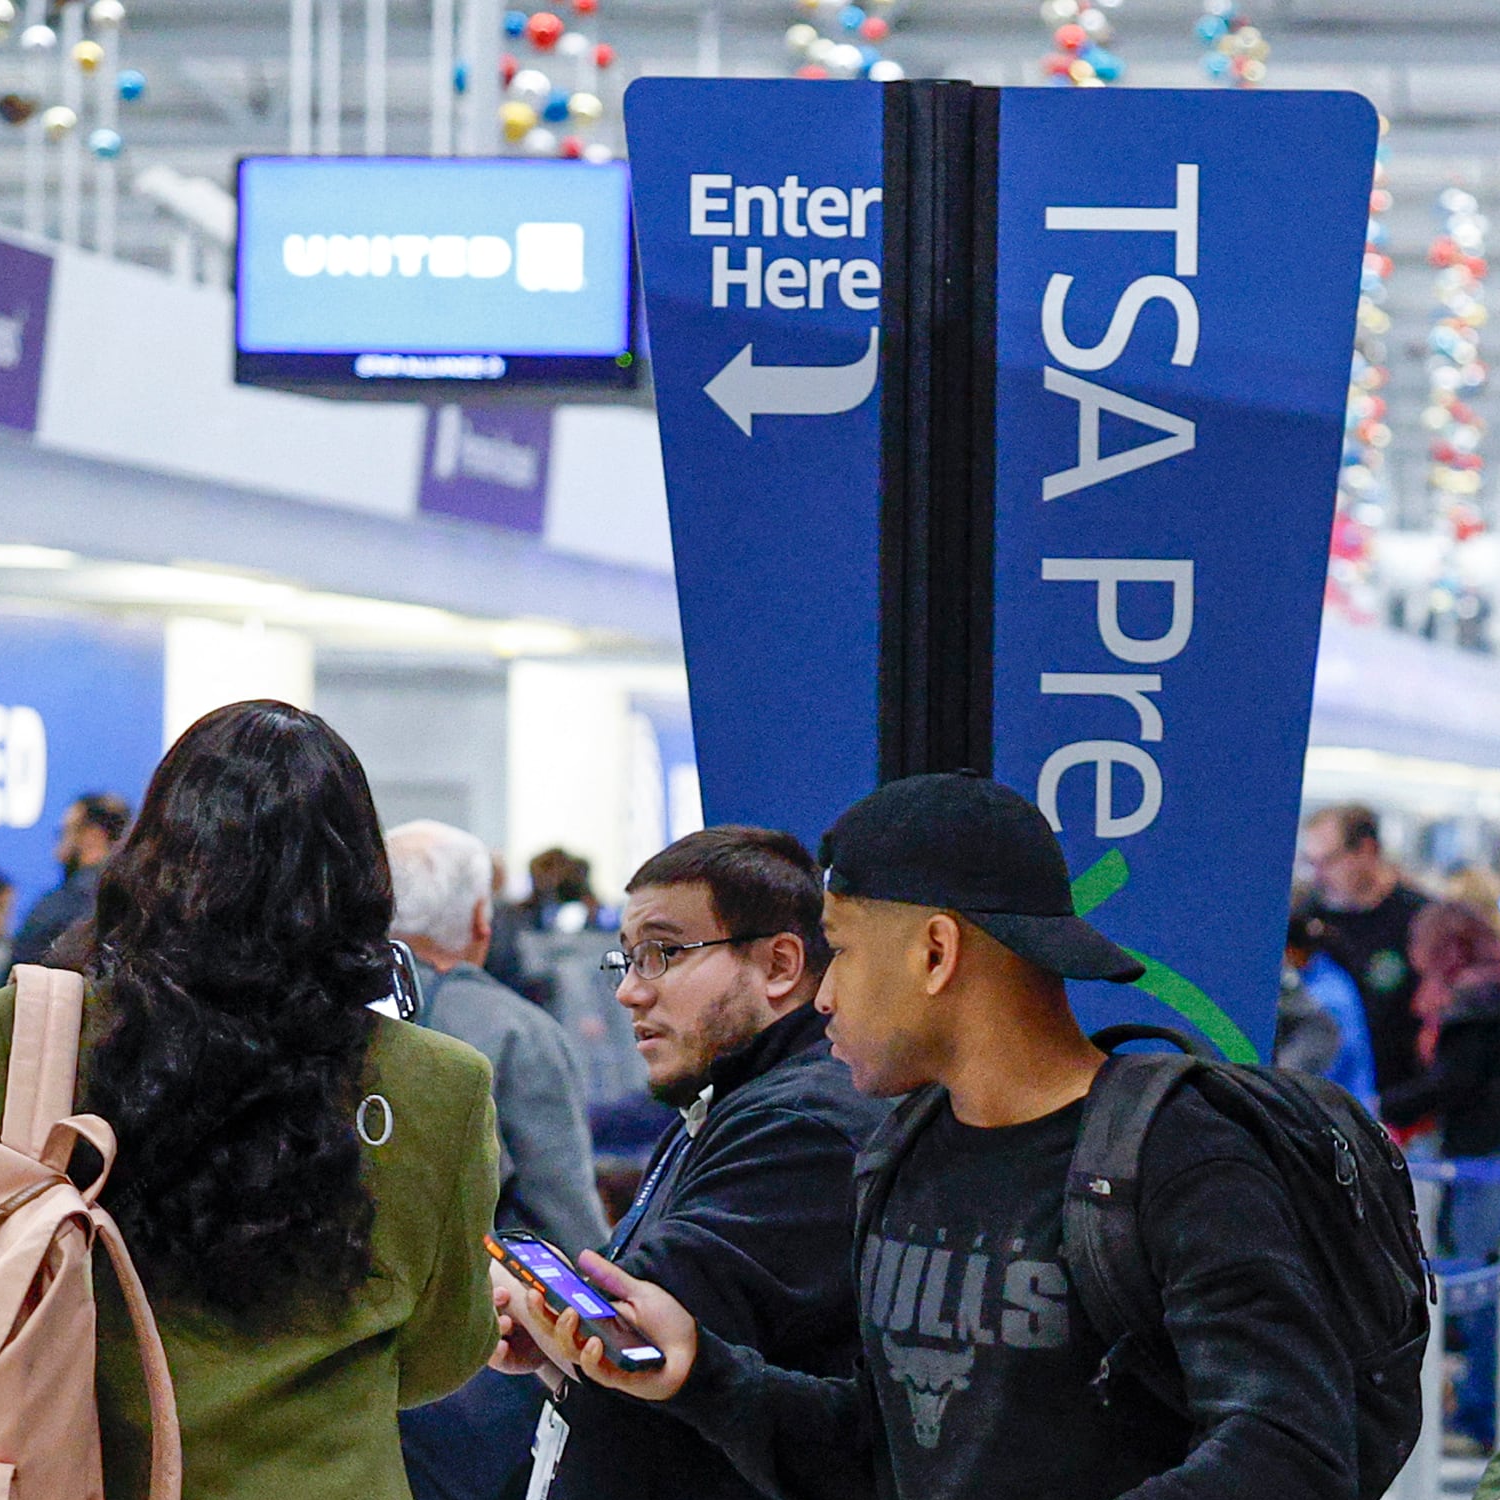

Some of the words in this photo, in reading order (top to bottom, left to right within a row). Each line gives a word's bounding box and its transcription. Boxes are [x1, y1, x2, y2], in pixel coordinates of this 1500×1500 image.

[689, 173, 883, 238] Enter
[282, 233, 513, 278] UNITED
[710, 246, 882, 310] Here
[1041, 163, 1200, 502] TSA
[1036, 557, 1195, 839] Pre
